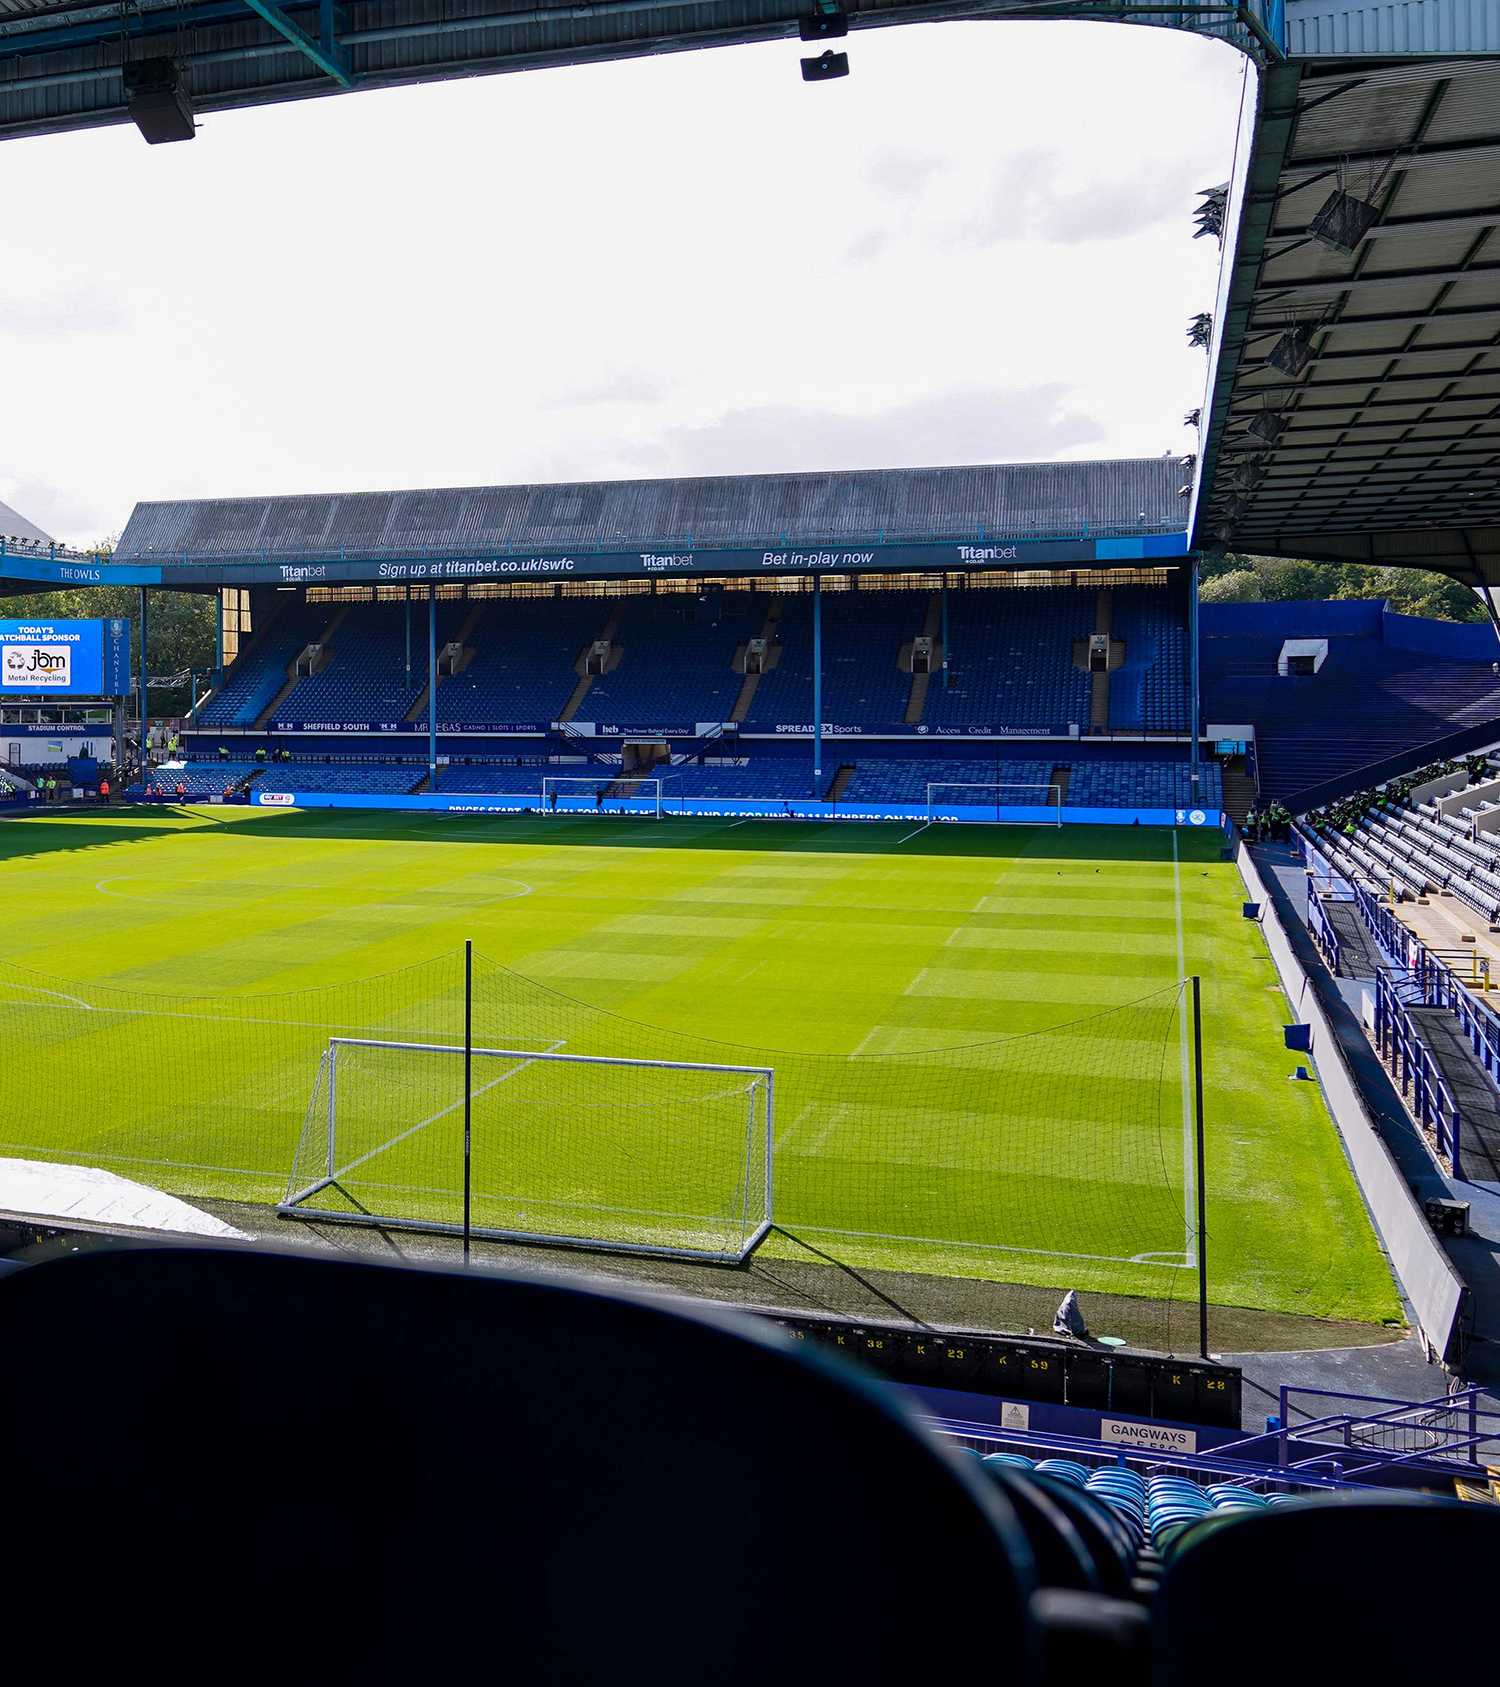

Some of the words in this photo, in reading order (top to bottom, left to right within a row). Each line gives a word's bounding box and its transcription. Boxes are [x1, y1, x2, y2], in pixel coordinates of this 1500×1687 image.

[957, 546, 1017, 559] Titanbet
[640, 554, 694, 567] Titanbet
[762, 552, 787, 565] Bet
[790, 551, 839, 567] in-play
[842, 553, 873, 563] now
[279, 565, 326, 577] Titanbet
[378, 562, 407, 578] Sign
[410, 566, 426, 576] up
[430, 563, 442, 574] at
[446, 557, 574, 573] titanbet.co.uk/swfc
[60, 567, 73, 579] THE
[74, 568, 100, 580] OWLS
[27, 650, 65, 671] jbm
[30, 674, 66, 683] Recycling
[303, 723, 340, 731] SHEFFIELD
[343, 723, 369, 731] SOUTH
[414, 723, 428, 732] MR
[834, 725, 862, 734] Sports
[935, 726, 961, 735] Access
[968, 726, 992, 734] Credit
[1000, 726, 1051, 735] Management
[61, 1238, 67, 1246] 5
[837, 1336, 845, 1345] K
[917, 1345, 925, 1354] K
[947, 1349, 964, 1359] 23
[999, 1356, 1007, 1365] K
[1030, 1360, 1048, 1370] 59
[1172, 1375, 1181, 1385] K
[1111, 1424, 1187, 1444] GANGWAYS
